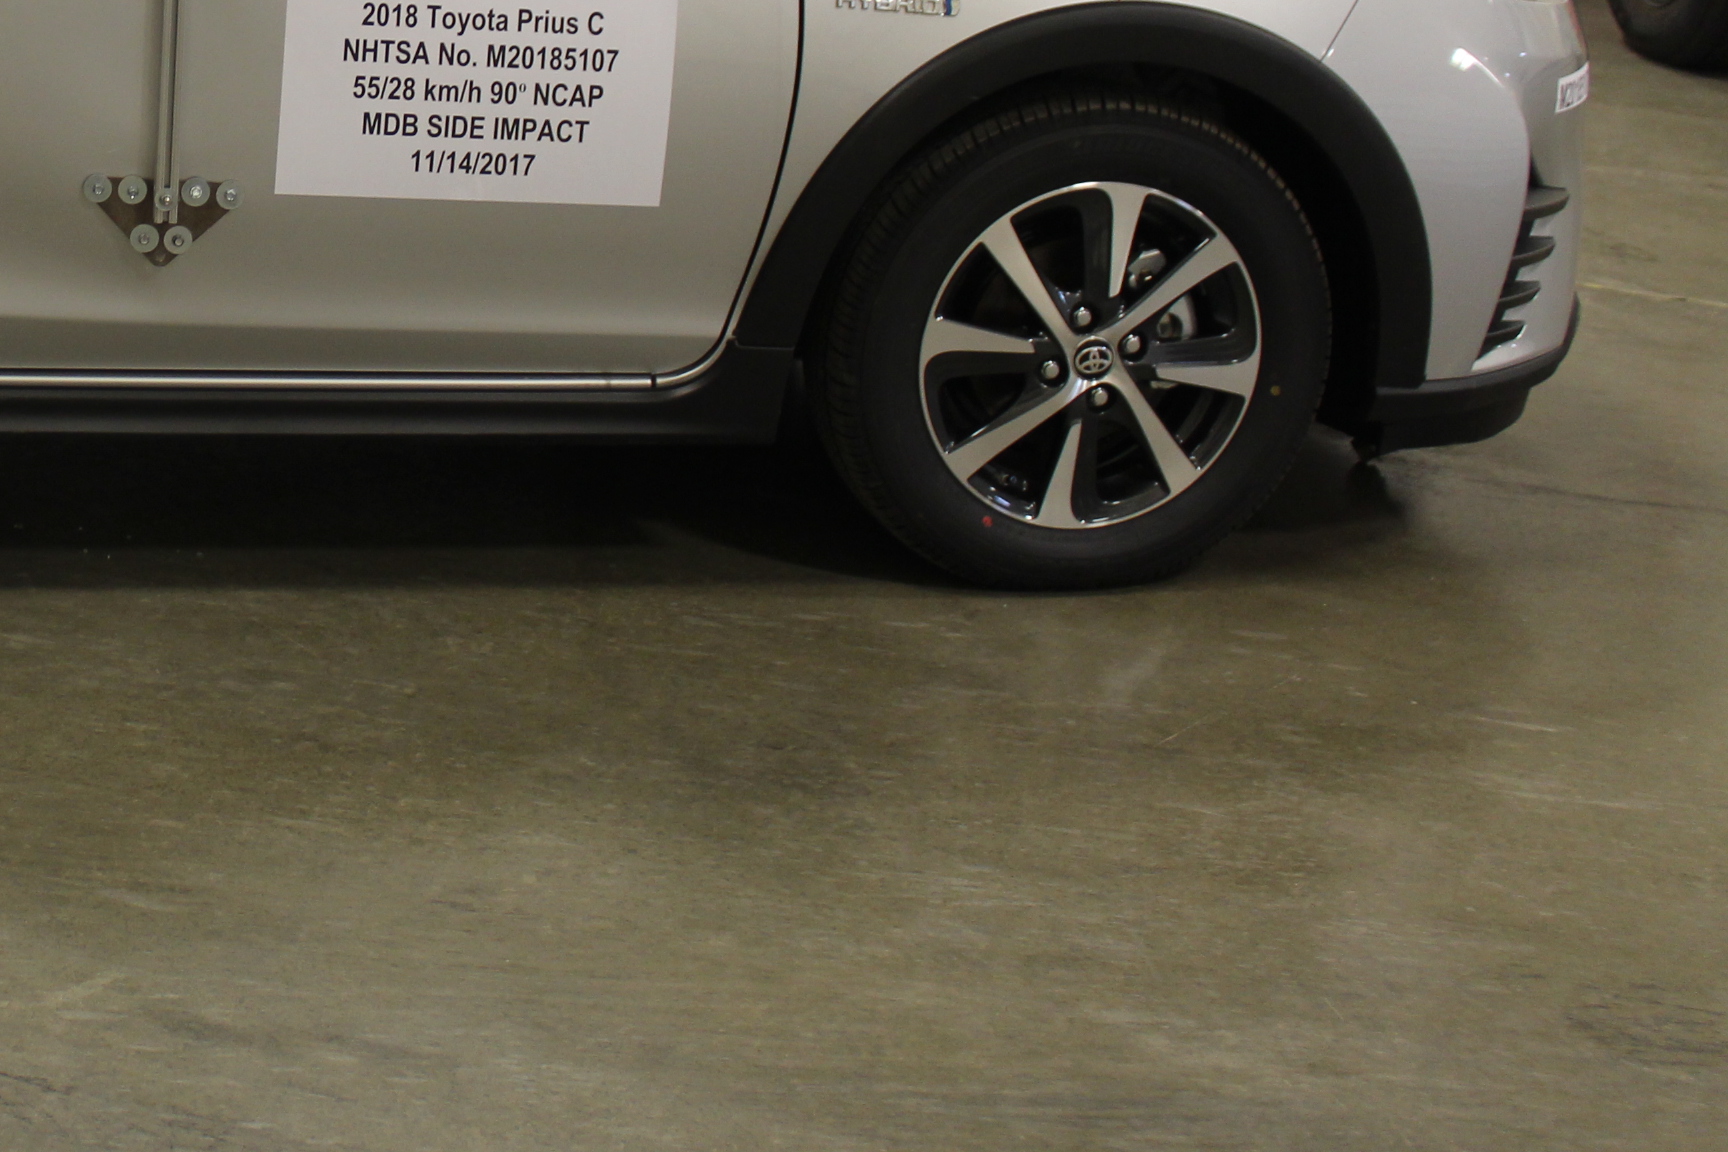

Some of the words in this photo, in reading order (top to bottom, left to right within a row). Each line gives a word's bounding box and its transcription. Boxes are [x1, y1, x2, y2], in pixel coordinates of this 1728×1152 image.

[362, 2, 417, 28] 2018
[427, 5, 508, 36] Toyota
[518, 9, 578, 34] Prius
[588, 12, 603, 35] C
[344, 38, 429, 64] NHTSA
[439, 43, 476, 66] No.
[487, 45, 619, 72] M20185107
[353, 76, 415, 100] 55/28
[424, 78, 481, 103] km/h
[534, 83, 603, 107] NCAP
[363, 112, 418, 136] MDB
[427, 115, 485, 139] SIDE
[494, 117, 590, 143] IMPACT
[412, 150, 535, 176] 11/14/2017
